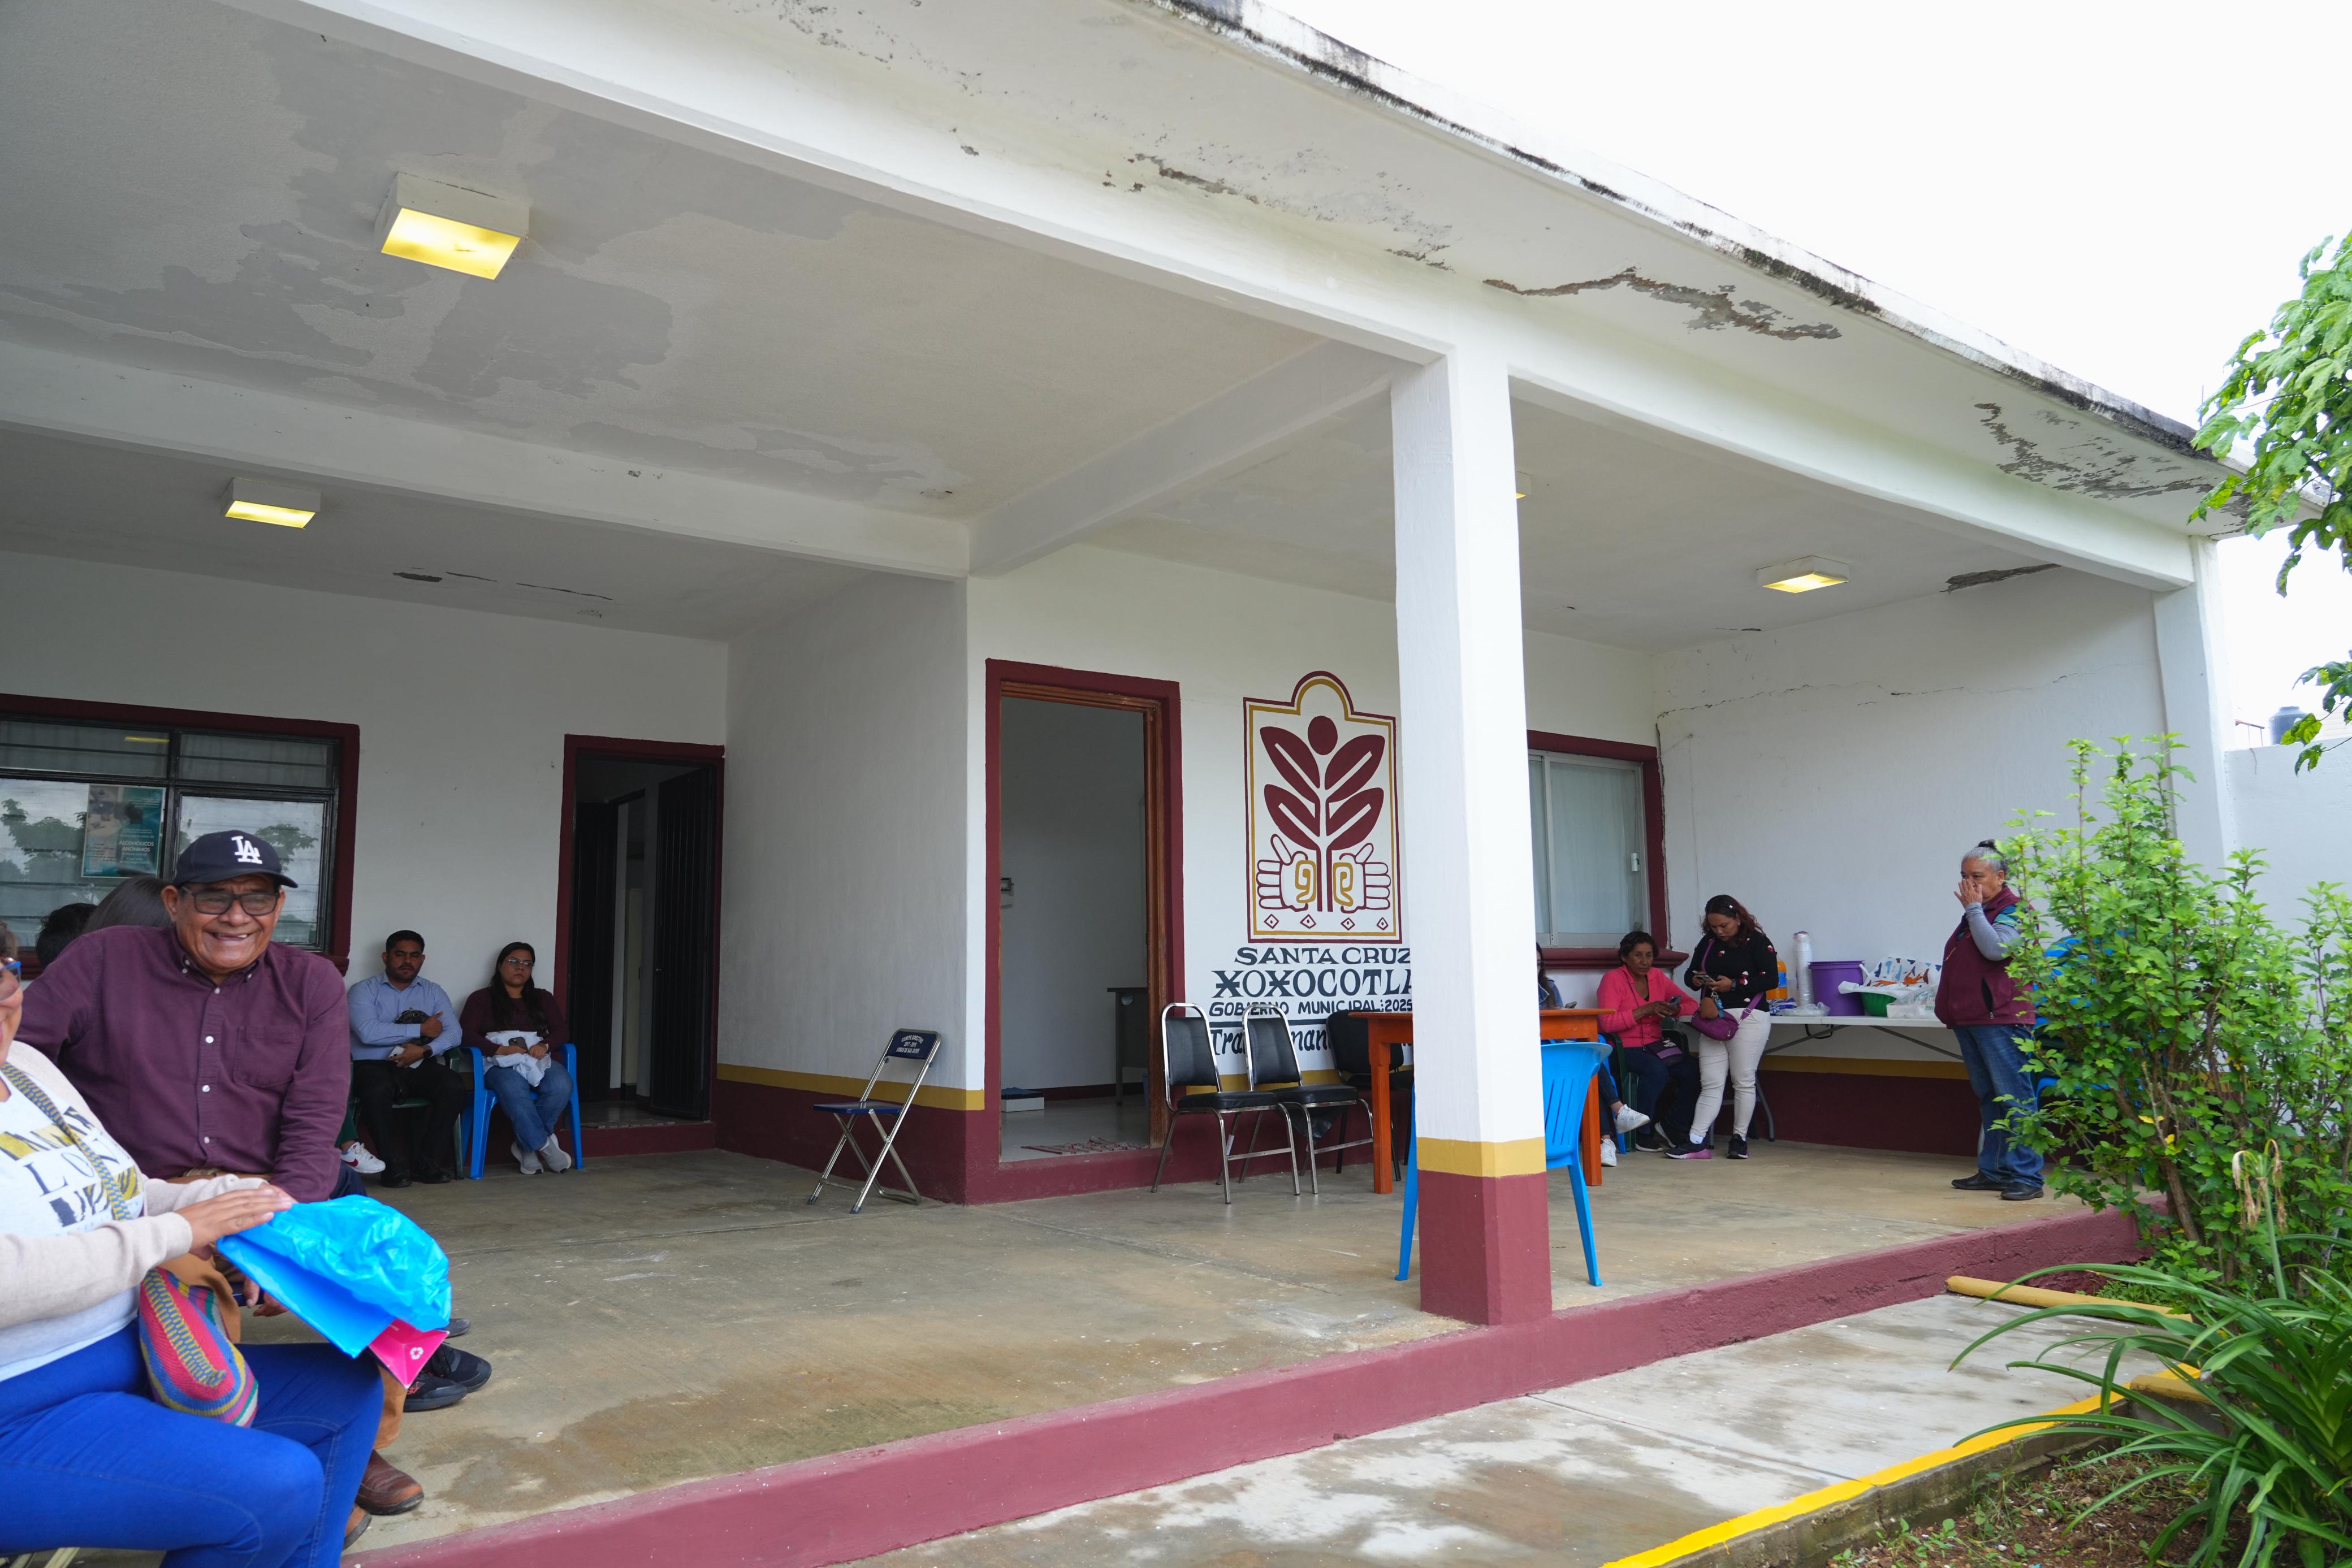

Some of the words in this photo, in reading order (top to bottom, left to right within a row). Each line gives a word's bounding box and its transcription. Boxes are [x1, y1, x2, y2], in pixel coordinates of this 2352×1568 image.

[231, 835, 262, 864] LA
[1234, 947, 1339, 965] SANTA
[1342, 947, 1411, 965] CRUZ
